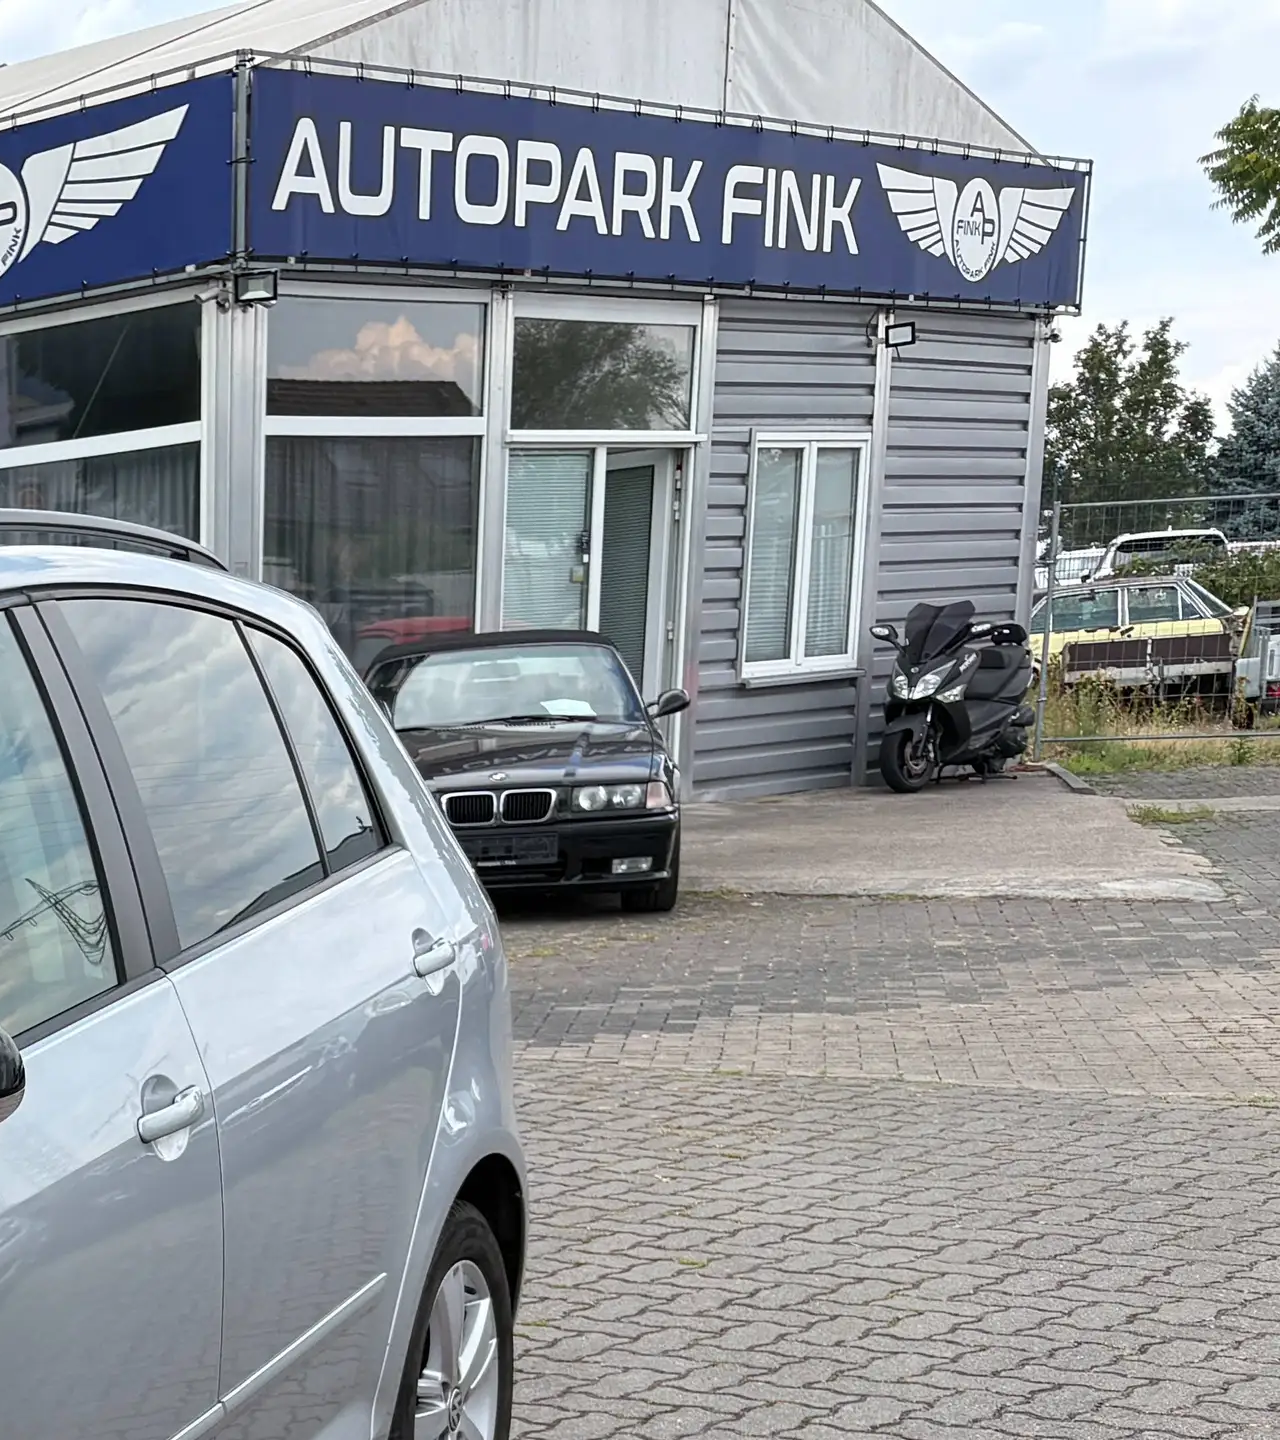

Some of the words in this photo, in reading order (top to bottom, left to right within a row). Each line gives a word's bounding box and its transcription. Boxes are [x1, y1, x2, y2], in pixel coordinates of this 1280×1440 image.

[271, 116, 704, 243] AUTOPARK
[721, 164, 863, 255] FINK
[1, 227, 22, 267] FINK
[956, 219, 981, 237] FINK
[954, 239, 984, 278] AUTOPARK
